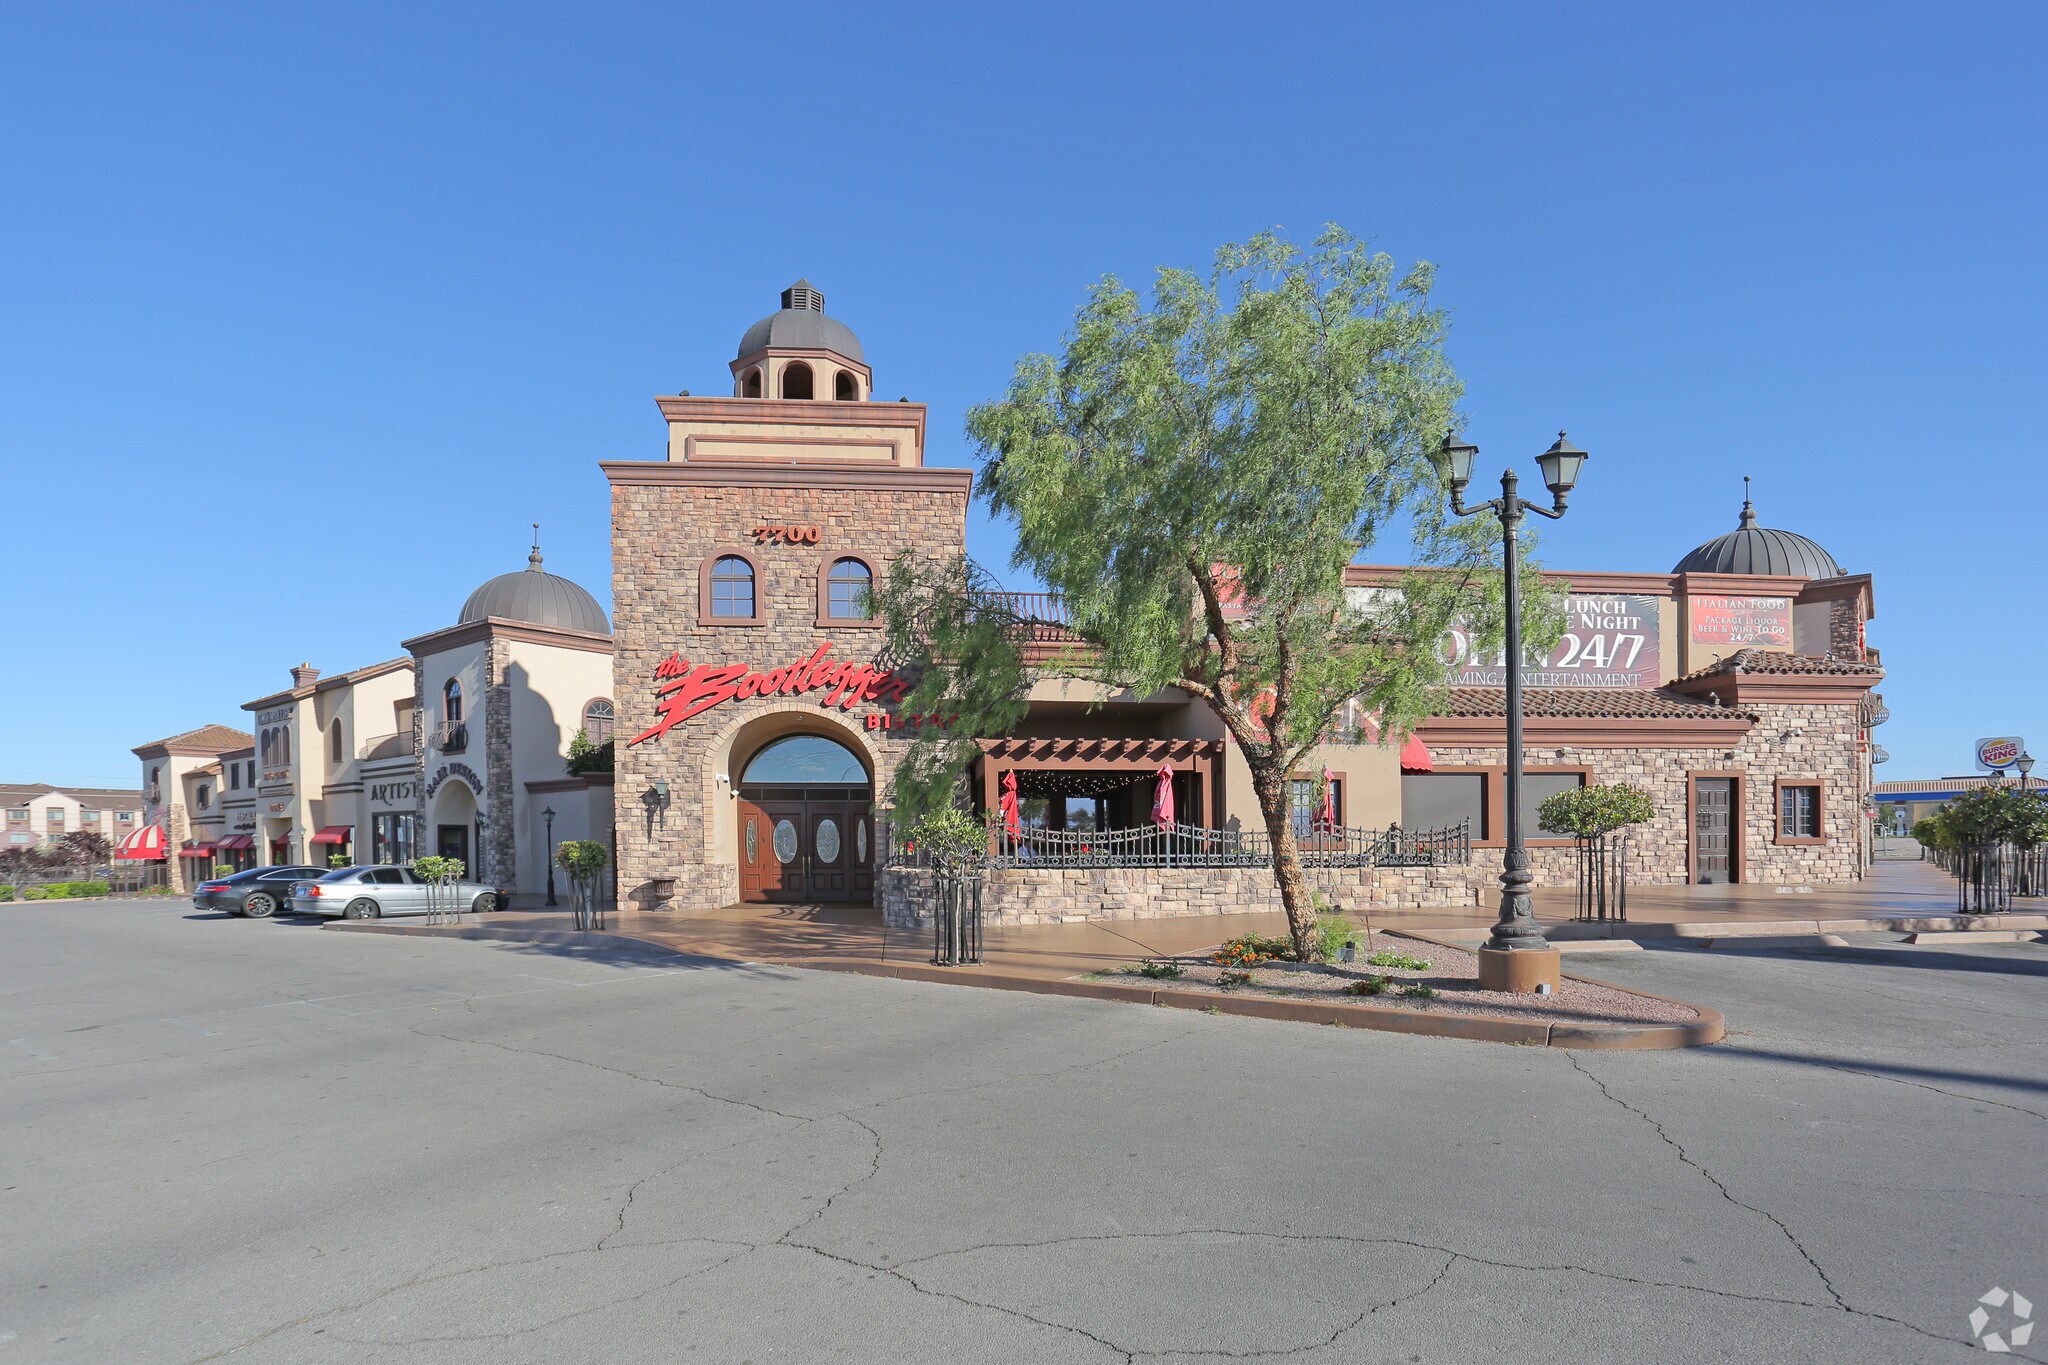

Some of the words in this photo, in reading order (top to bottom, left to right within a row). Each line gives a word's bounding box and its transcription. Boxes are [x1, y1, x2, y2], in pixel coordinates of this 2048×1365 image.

[756, 526, 822, 543] 7700
[1564, 599, 1626, 614] LUNCH
[1581, 613, 1641, 630] NIGHT
[1721, 625, 1728, 633] &
[1730, 633, 1754, 642] 24/7
[1556, 632, 1645, 669] 24/7
[657, 651, 690, 677] the
[1441, 672, 1498, 687] AMING
[1519, 673, 1642, 688] NTERTAINMENT
[629, 642, 909, 748] Bootlegger
[1983, 743, 2016, 755] BURGER
[1984, 749, 2017, 763] KING
[426, 766, 449, 800] HAIR
[449, 762, 484, 796] DESIGN
